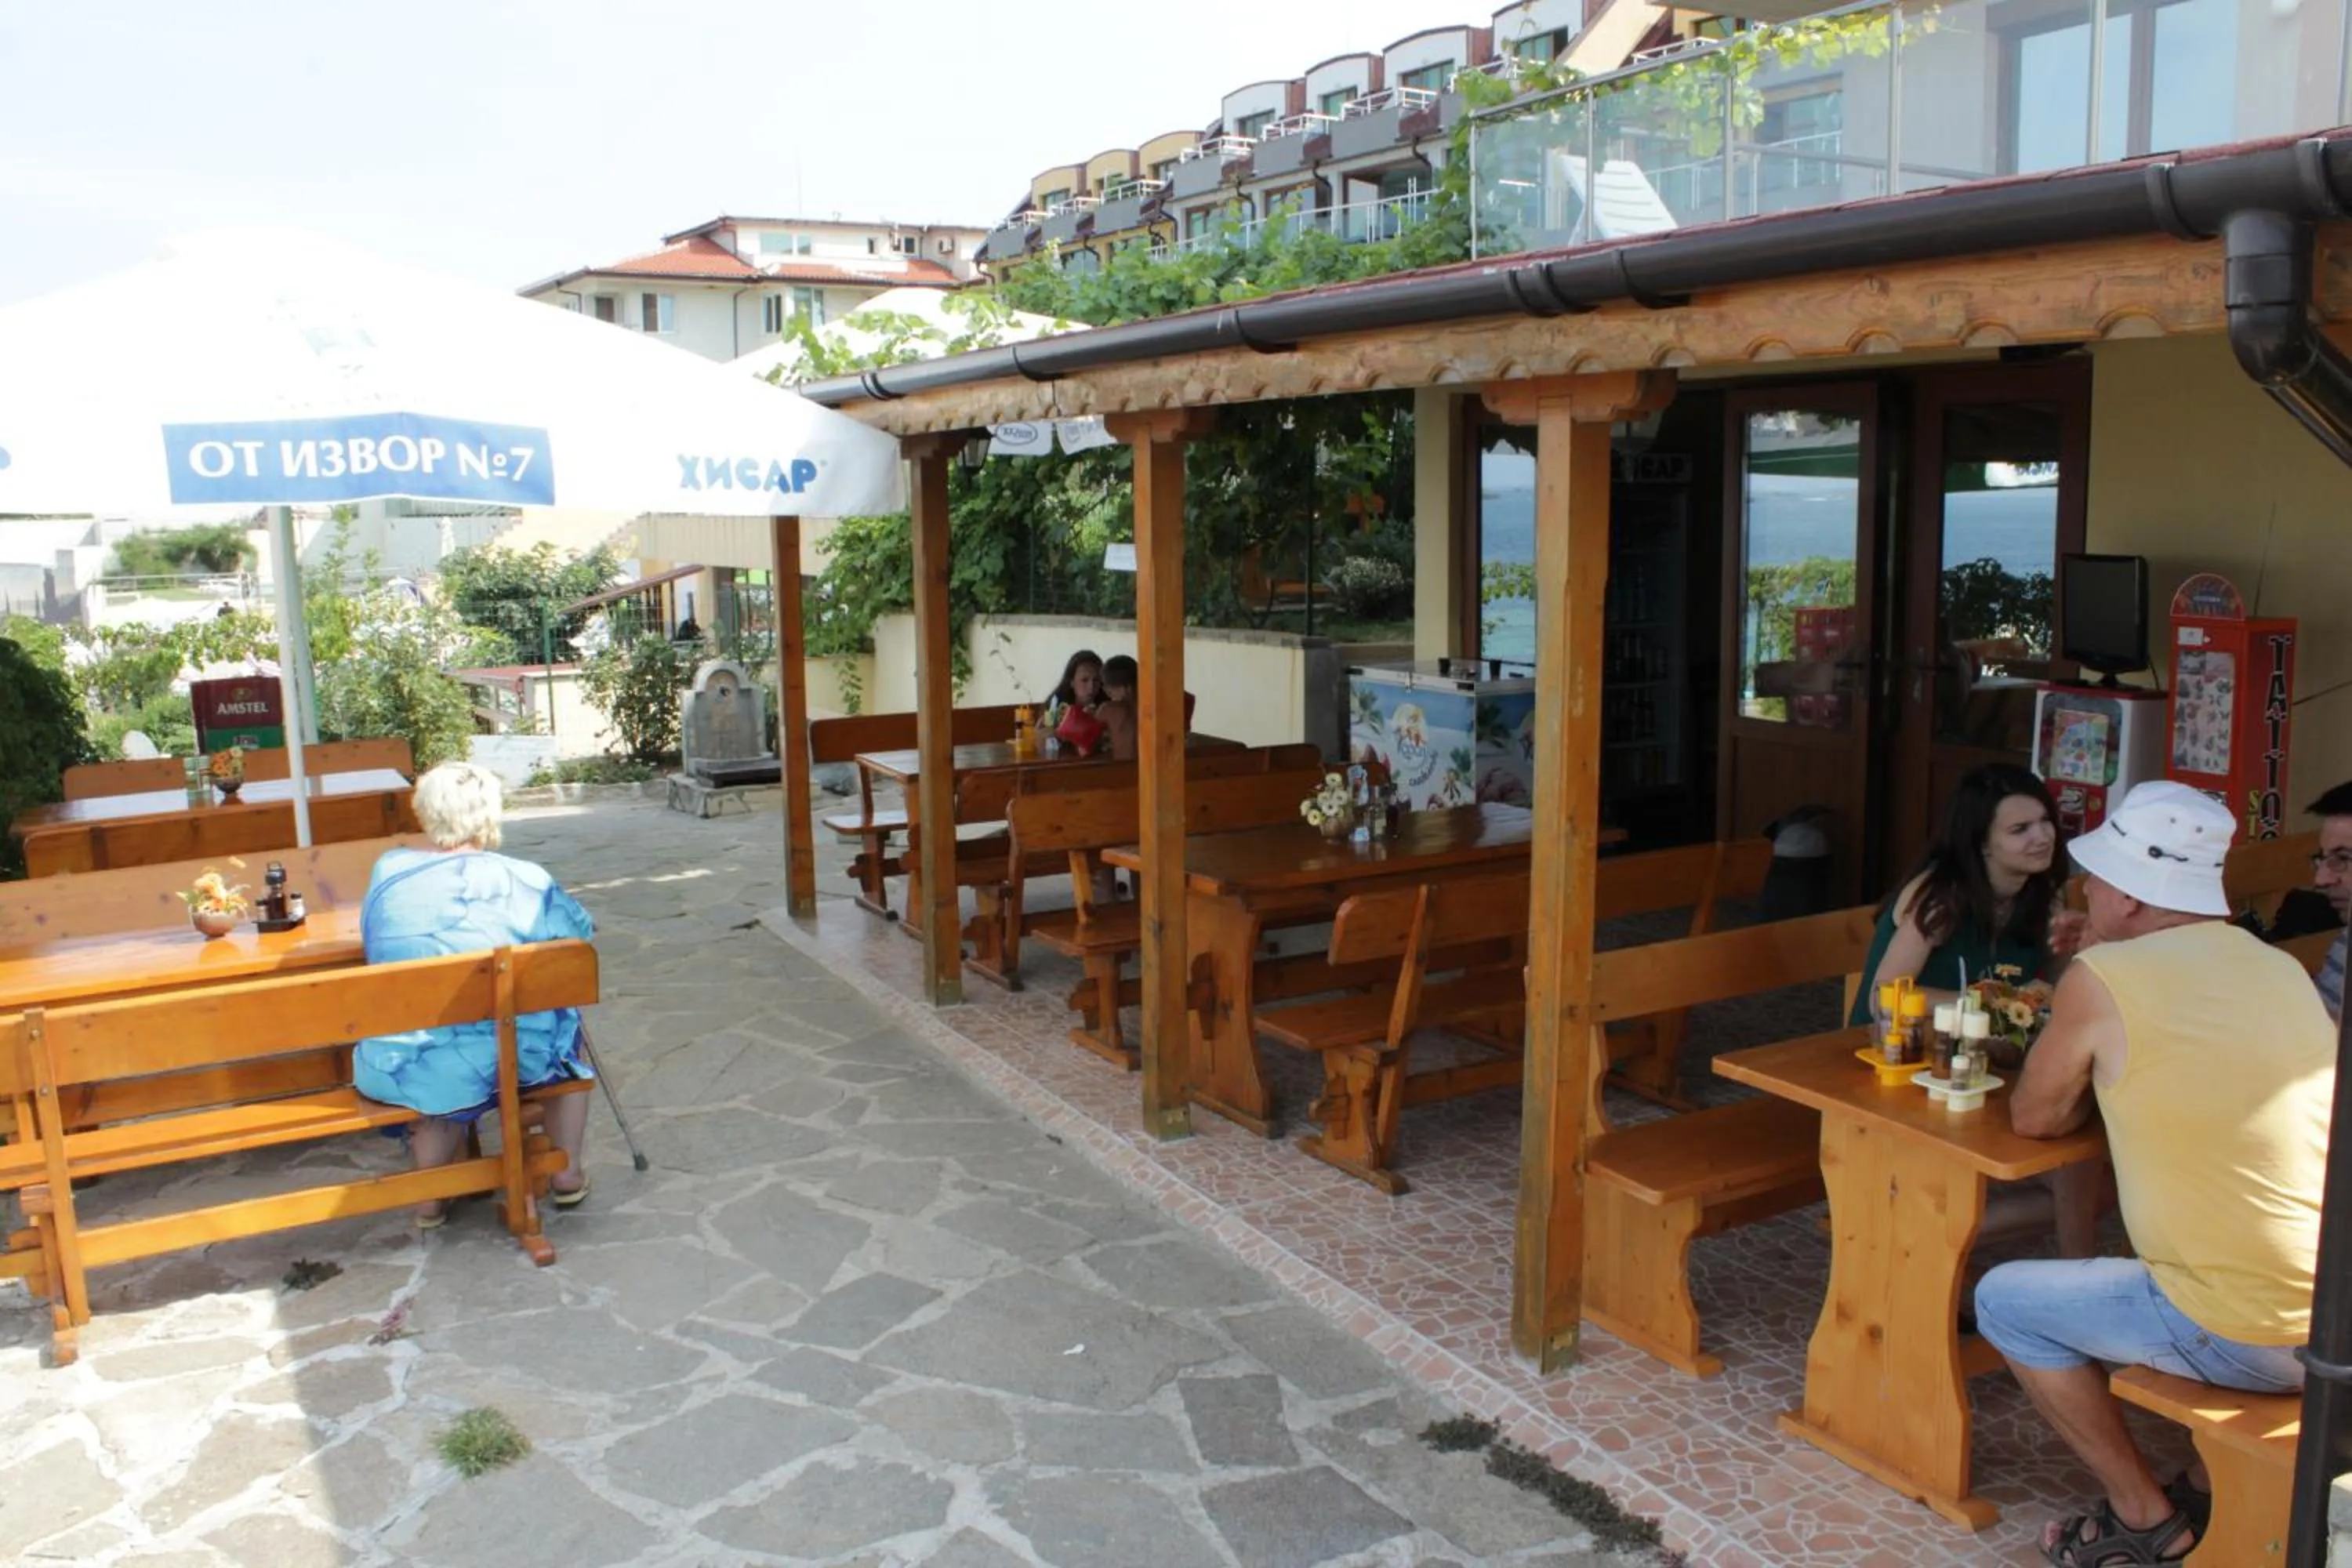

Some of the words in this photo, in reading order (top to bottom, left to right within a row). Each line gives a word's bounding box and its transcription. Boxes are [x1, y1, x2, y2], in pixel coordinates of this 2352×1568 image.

[190, 441, 265, 477] ОТ
[281, 436, 446, 477] ИЗВОР
[677, 454, 818, 493] ХИСАР
[217, 702, 269, 715] AMSTEL
